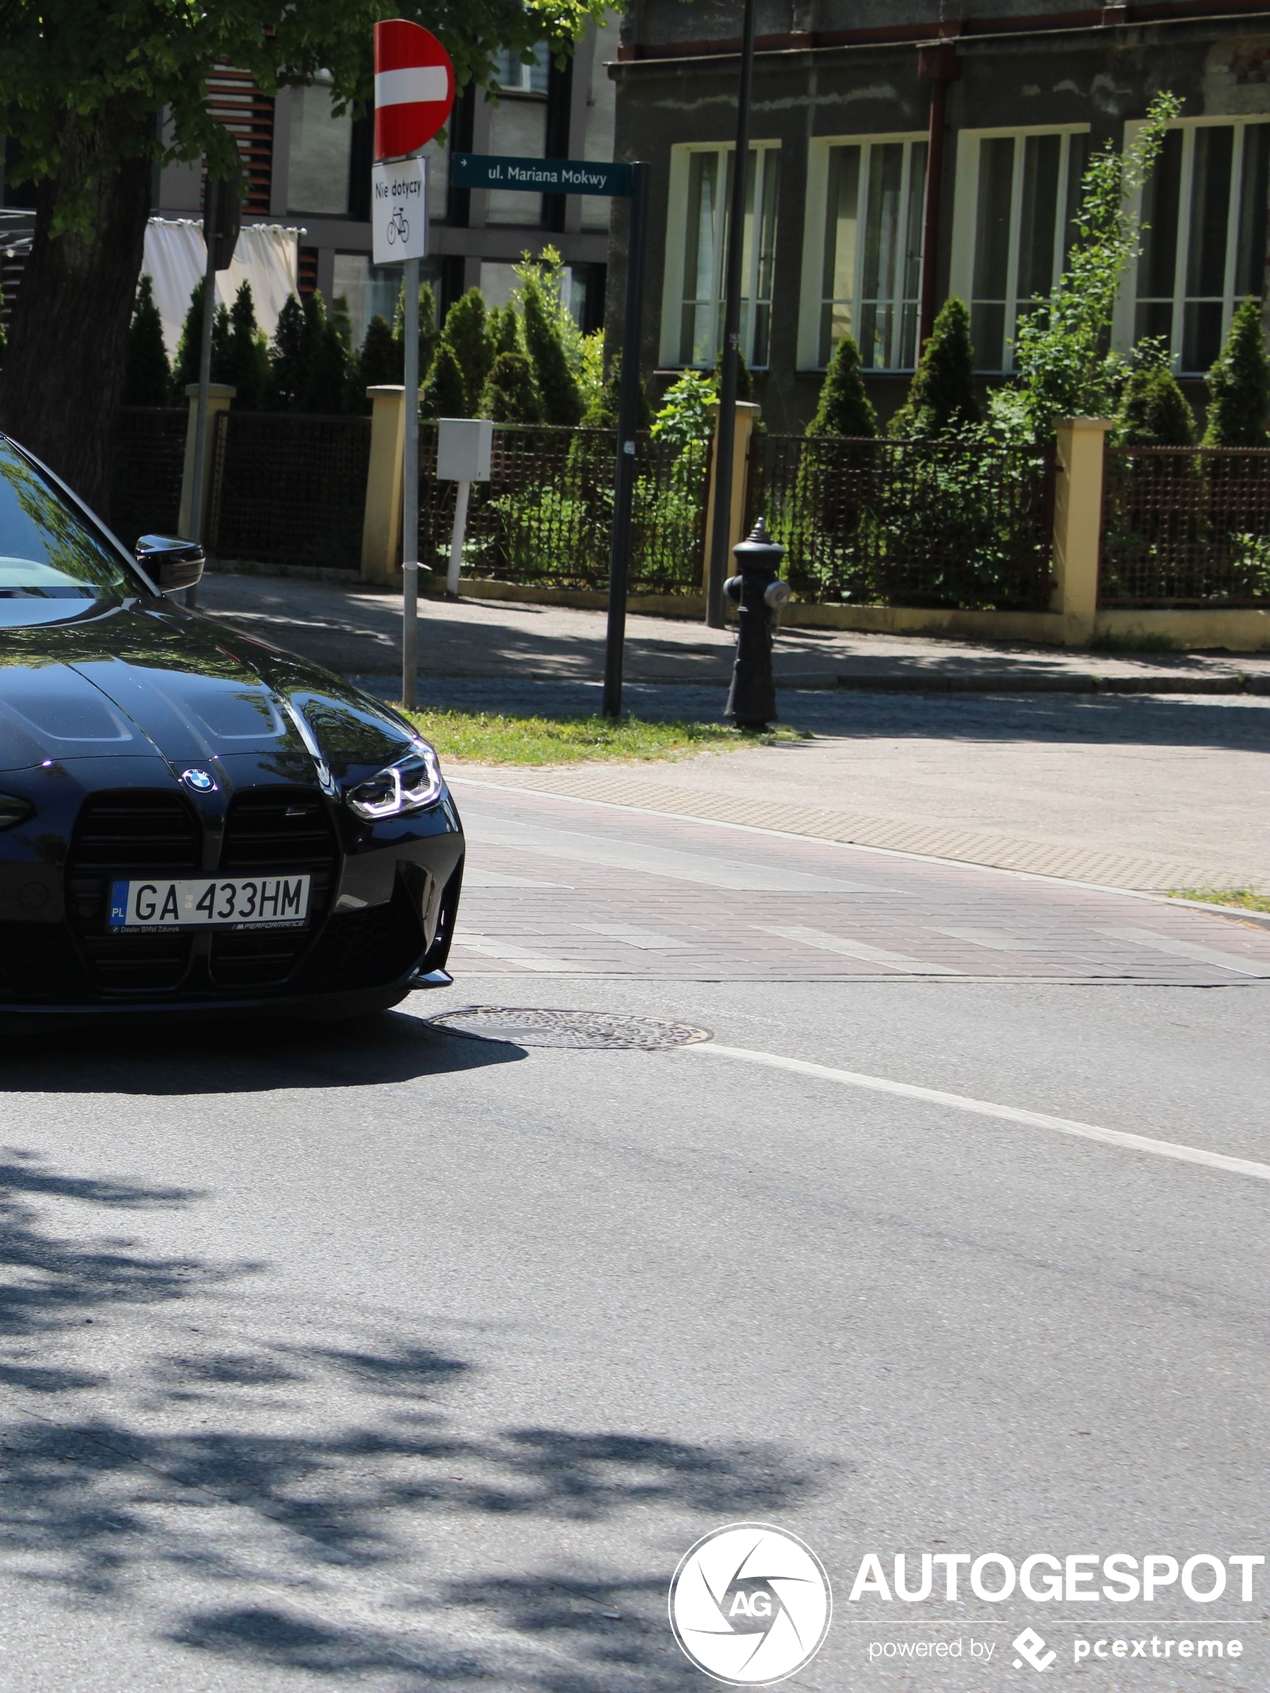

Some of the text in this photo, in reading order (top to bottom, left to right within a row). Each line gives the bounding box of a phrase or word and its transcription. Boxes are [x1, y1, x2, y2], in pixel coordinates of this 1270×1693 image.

[488, 165, 607, 189] ul. Mariana Mokwy
[375, 179, 421, 199] Nie dotyczy
[135, 879, 303, 920] GA 433HM
[111, 908, 125, 918] PL
[158, 925, 180, 933] Zdunek
